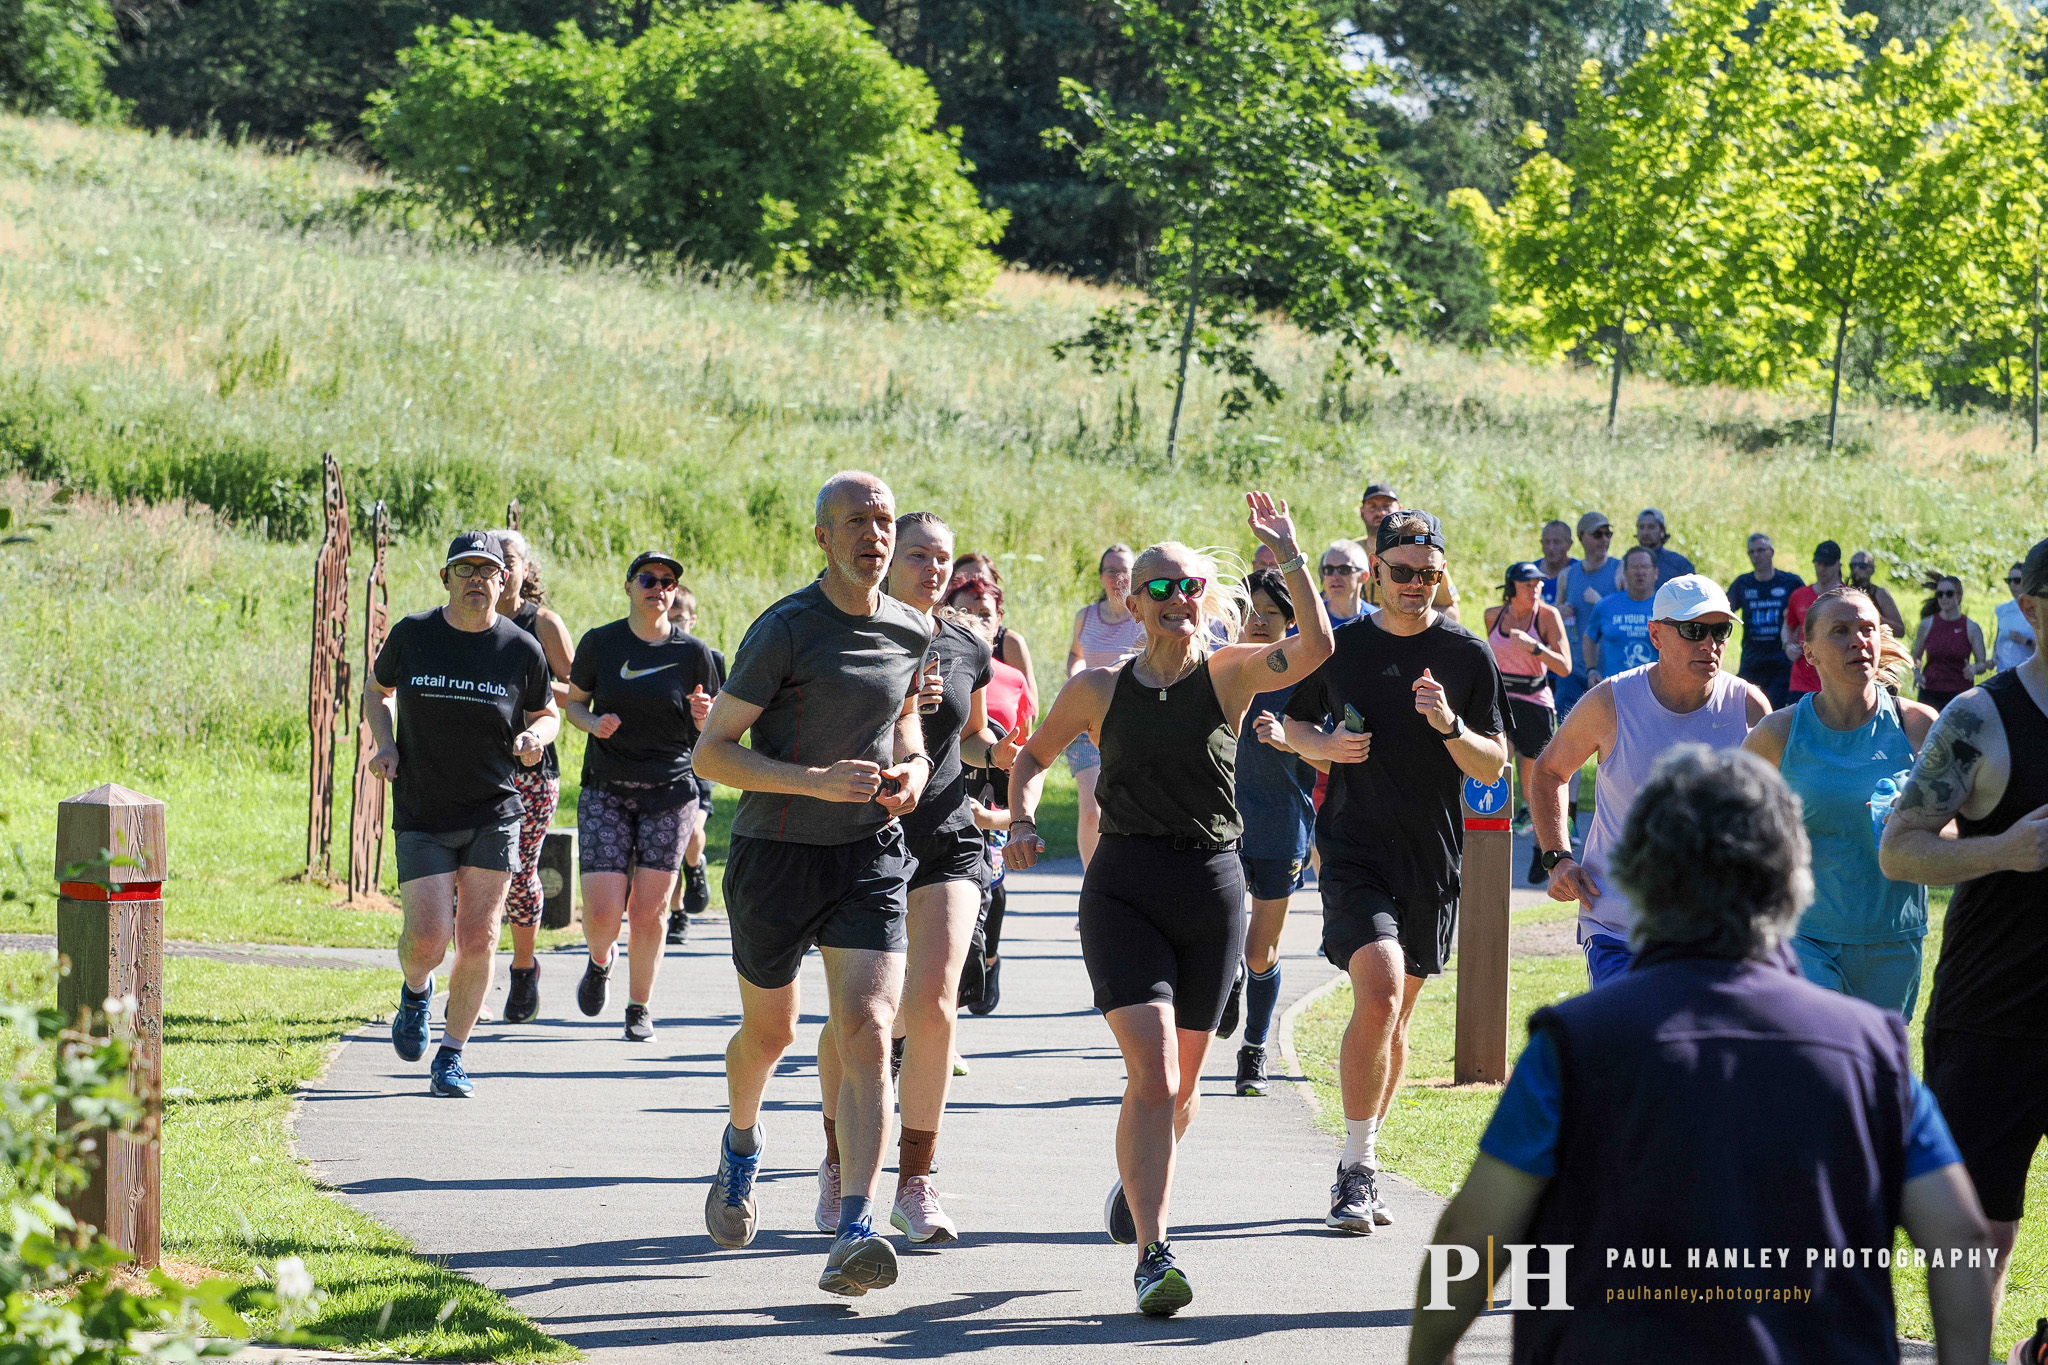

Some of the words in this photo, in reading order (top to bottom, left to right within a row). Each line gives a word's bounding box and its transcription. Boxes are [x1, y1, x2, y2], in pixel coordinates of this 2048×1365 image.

[1624, 614, 1646, 625] YOUR
[411, 674, 446, 688] retail
[449, 678, 474, 691] run
[477, 681, 509, 697] club.
